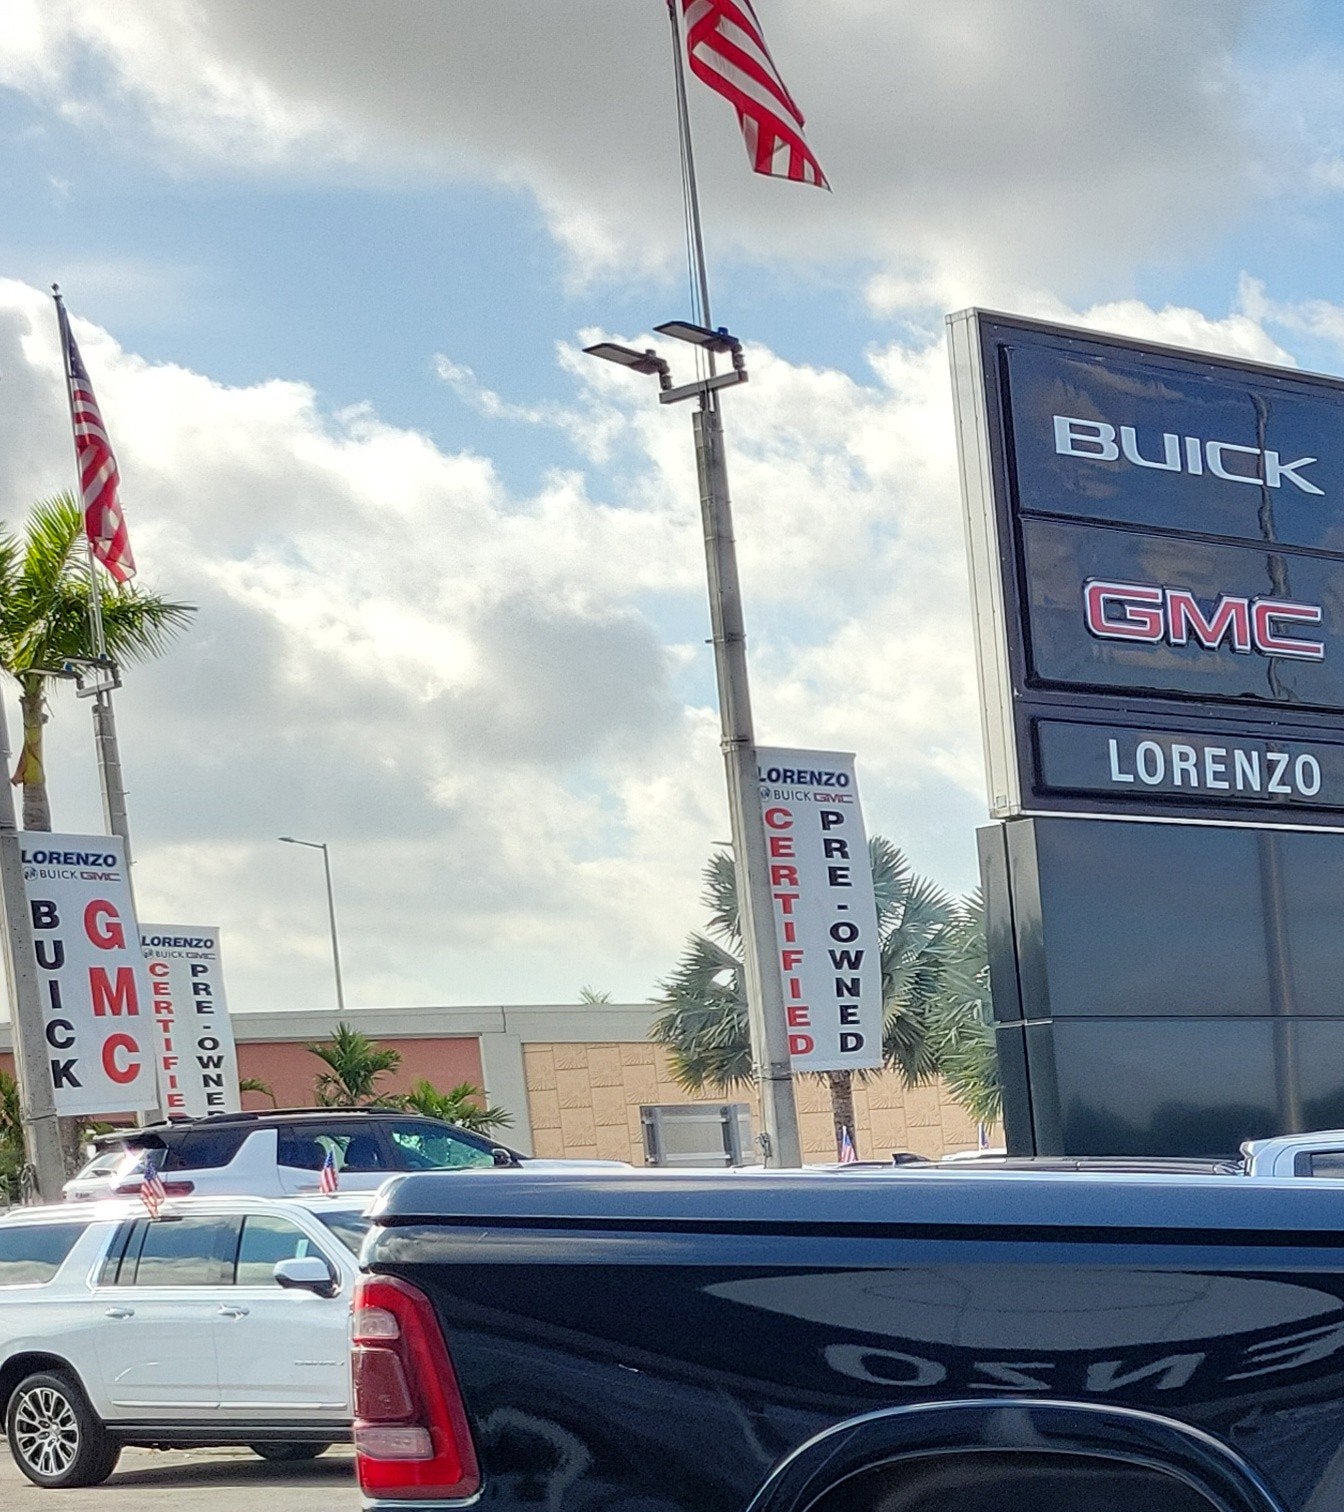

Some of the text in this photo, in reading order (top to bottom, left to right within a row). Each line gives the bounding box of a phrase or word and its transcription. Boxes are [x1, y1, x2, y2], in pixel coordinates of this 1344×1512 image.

[1053, 415, 1325, 495] BUICK
[1083, 577, 1325, 662] GMC
[758, 767, 849, 788] LORENZO
[774, 790, 853, 804] BUICK GMC
[1109, 739, 1321, 796] LORENZO
[21, 850, 117, 867] LORENZO
[39, 869, 121, 882] BUICK GMC
[141, 936, 214, 949] LORENZO
[155, 951, 184, 959] BUICK
[764, 807, 814, 1056] CERTIFIED
[820, 810, 864, 1053] PRE-OWNED
[30, 900, 82, 1088] BUICK
[84, 899, 140, 1084] GMC
[149, 963, 187, 1117] CERTIFIE
[190, 964, 226, 1115] PRE-OWNE
